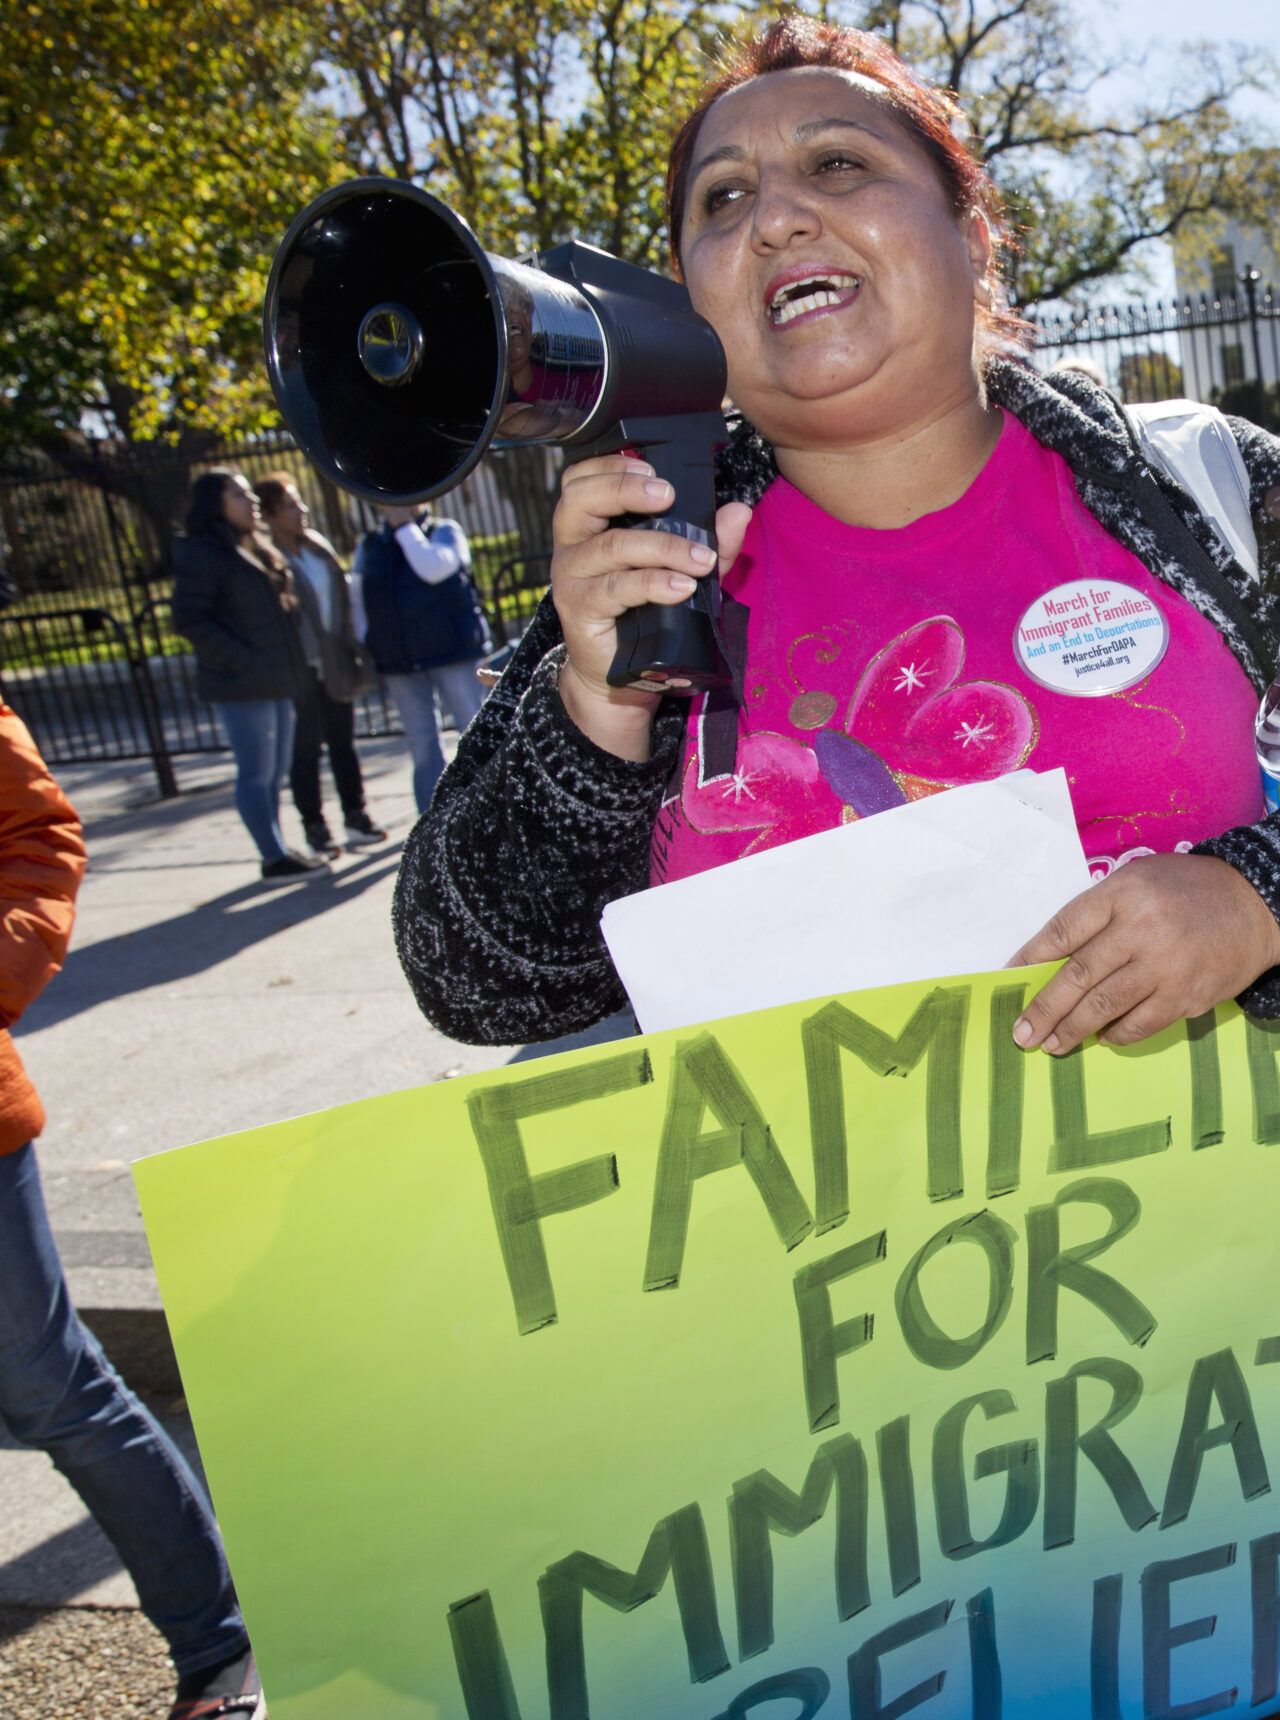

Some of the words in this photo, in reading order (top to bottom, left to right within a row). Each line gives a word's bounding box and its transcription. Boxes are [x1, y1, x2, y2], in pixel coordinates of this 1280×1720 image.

[1020, 612, 1093, 642] Immigrant
[1093, 599, 1152, 623] Families
[1043, 592, 1089, 617] March
[1089, 589, 1111, 604] for
[1026, 644, 1049, 659] And
[1049, 642, 1061, 652] an
[1061, 633, 1082, 649] End
[1083, 632, 1095, 643] to
[1094, 616, 1161, 640] Deportations
[1062, 636, 1137, 665] #MarchForDAPA
[1075, 654, 1131, 677] justice4all.org
[793, 1175, 1159, 1434] FOR
